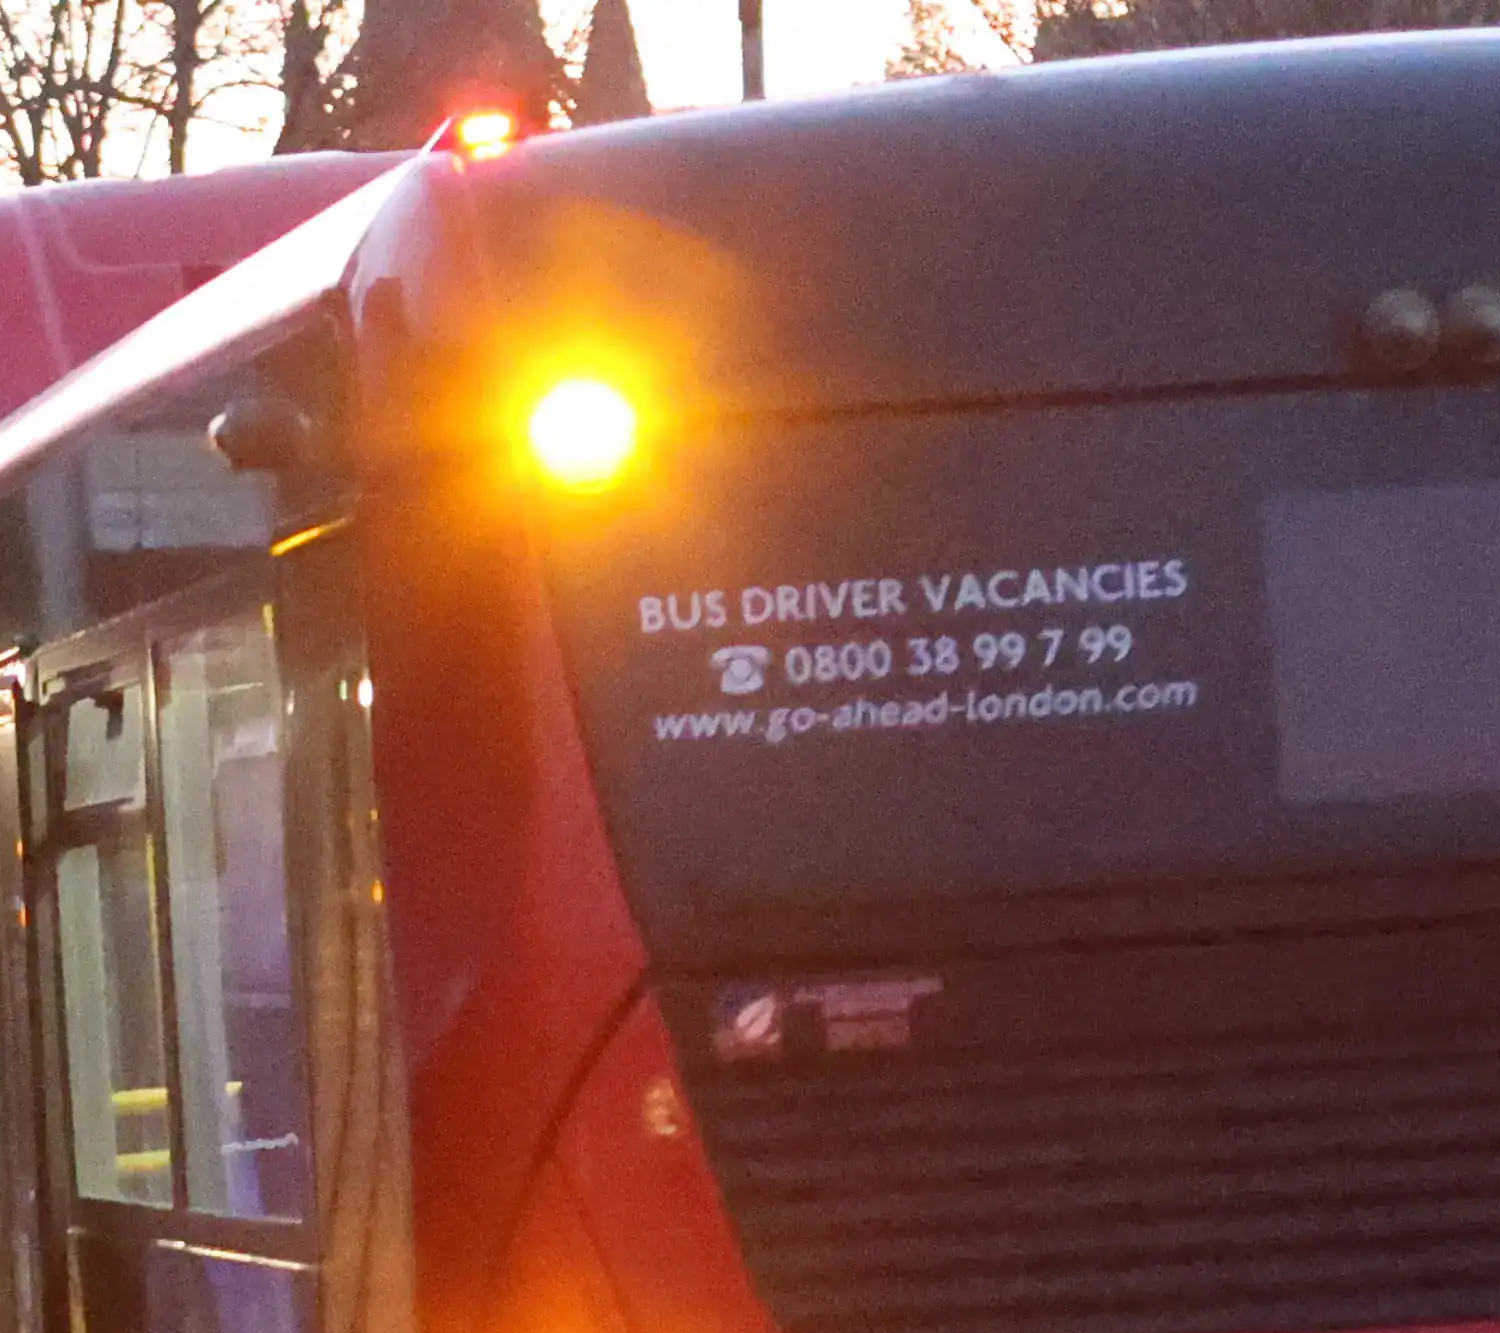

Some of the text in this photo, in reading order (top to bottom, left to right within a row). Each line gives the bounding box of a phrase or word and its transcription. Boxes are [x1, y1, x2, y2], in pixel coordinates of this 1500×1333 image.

[638, 559, 1189, 633] BUS DRIVER VACANCIES
[784, 624, 1132, 685] 0800 38 99 7 99
[654, 681, 1197, 742] www.go-ahead-london.com
